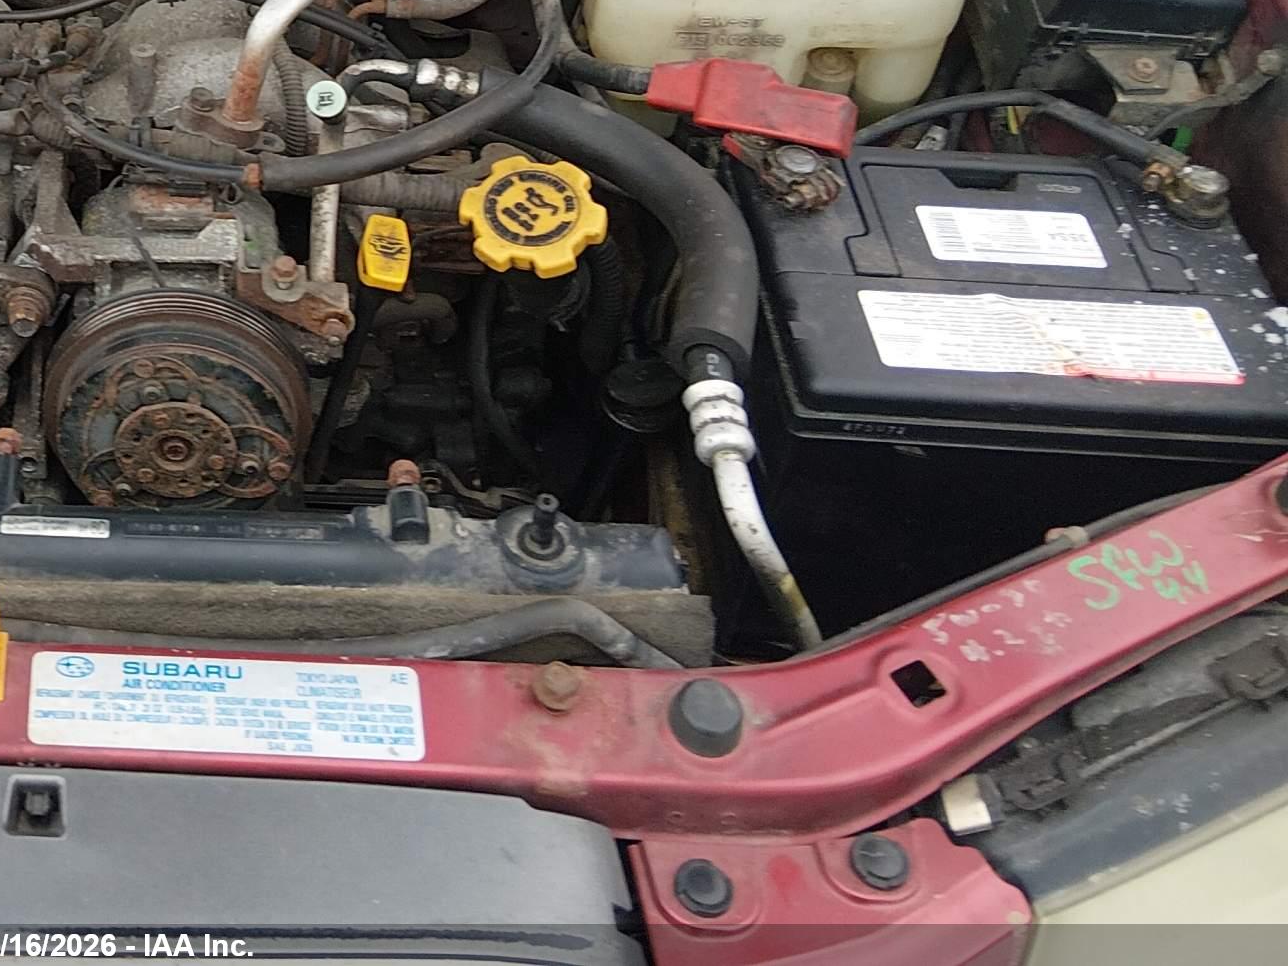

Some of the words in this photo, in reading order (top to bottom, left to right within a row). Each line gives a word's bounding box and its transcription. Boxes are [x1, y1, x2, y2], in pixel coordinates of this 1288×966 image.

[122, 660, 243, 680] SUBARU
[121, 679, 142, 690] AIR
[145, 679, 227, 693] CONDITIONER
